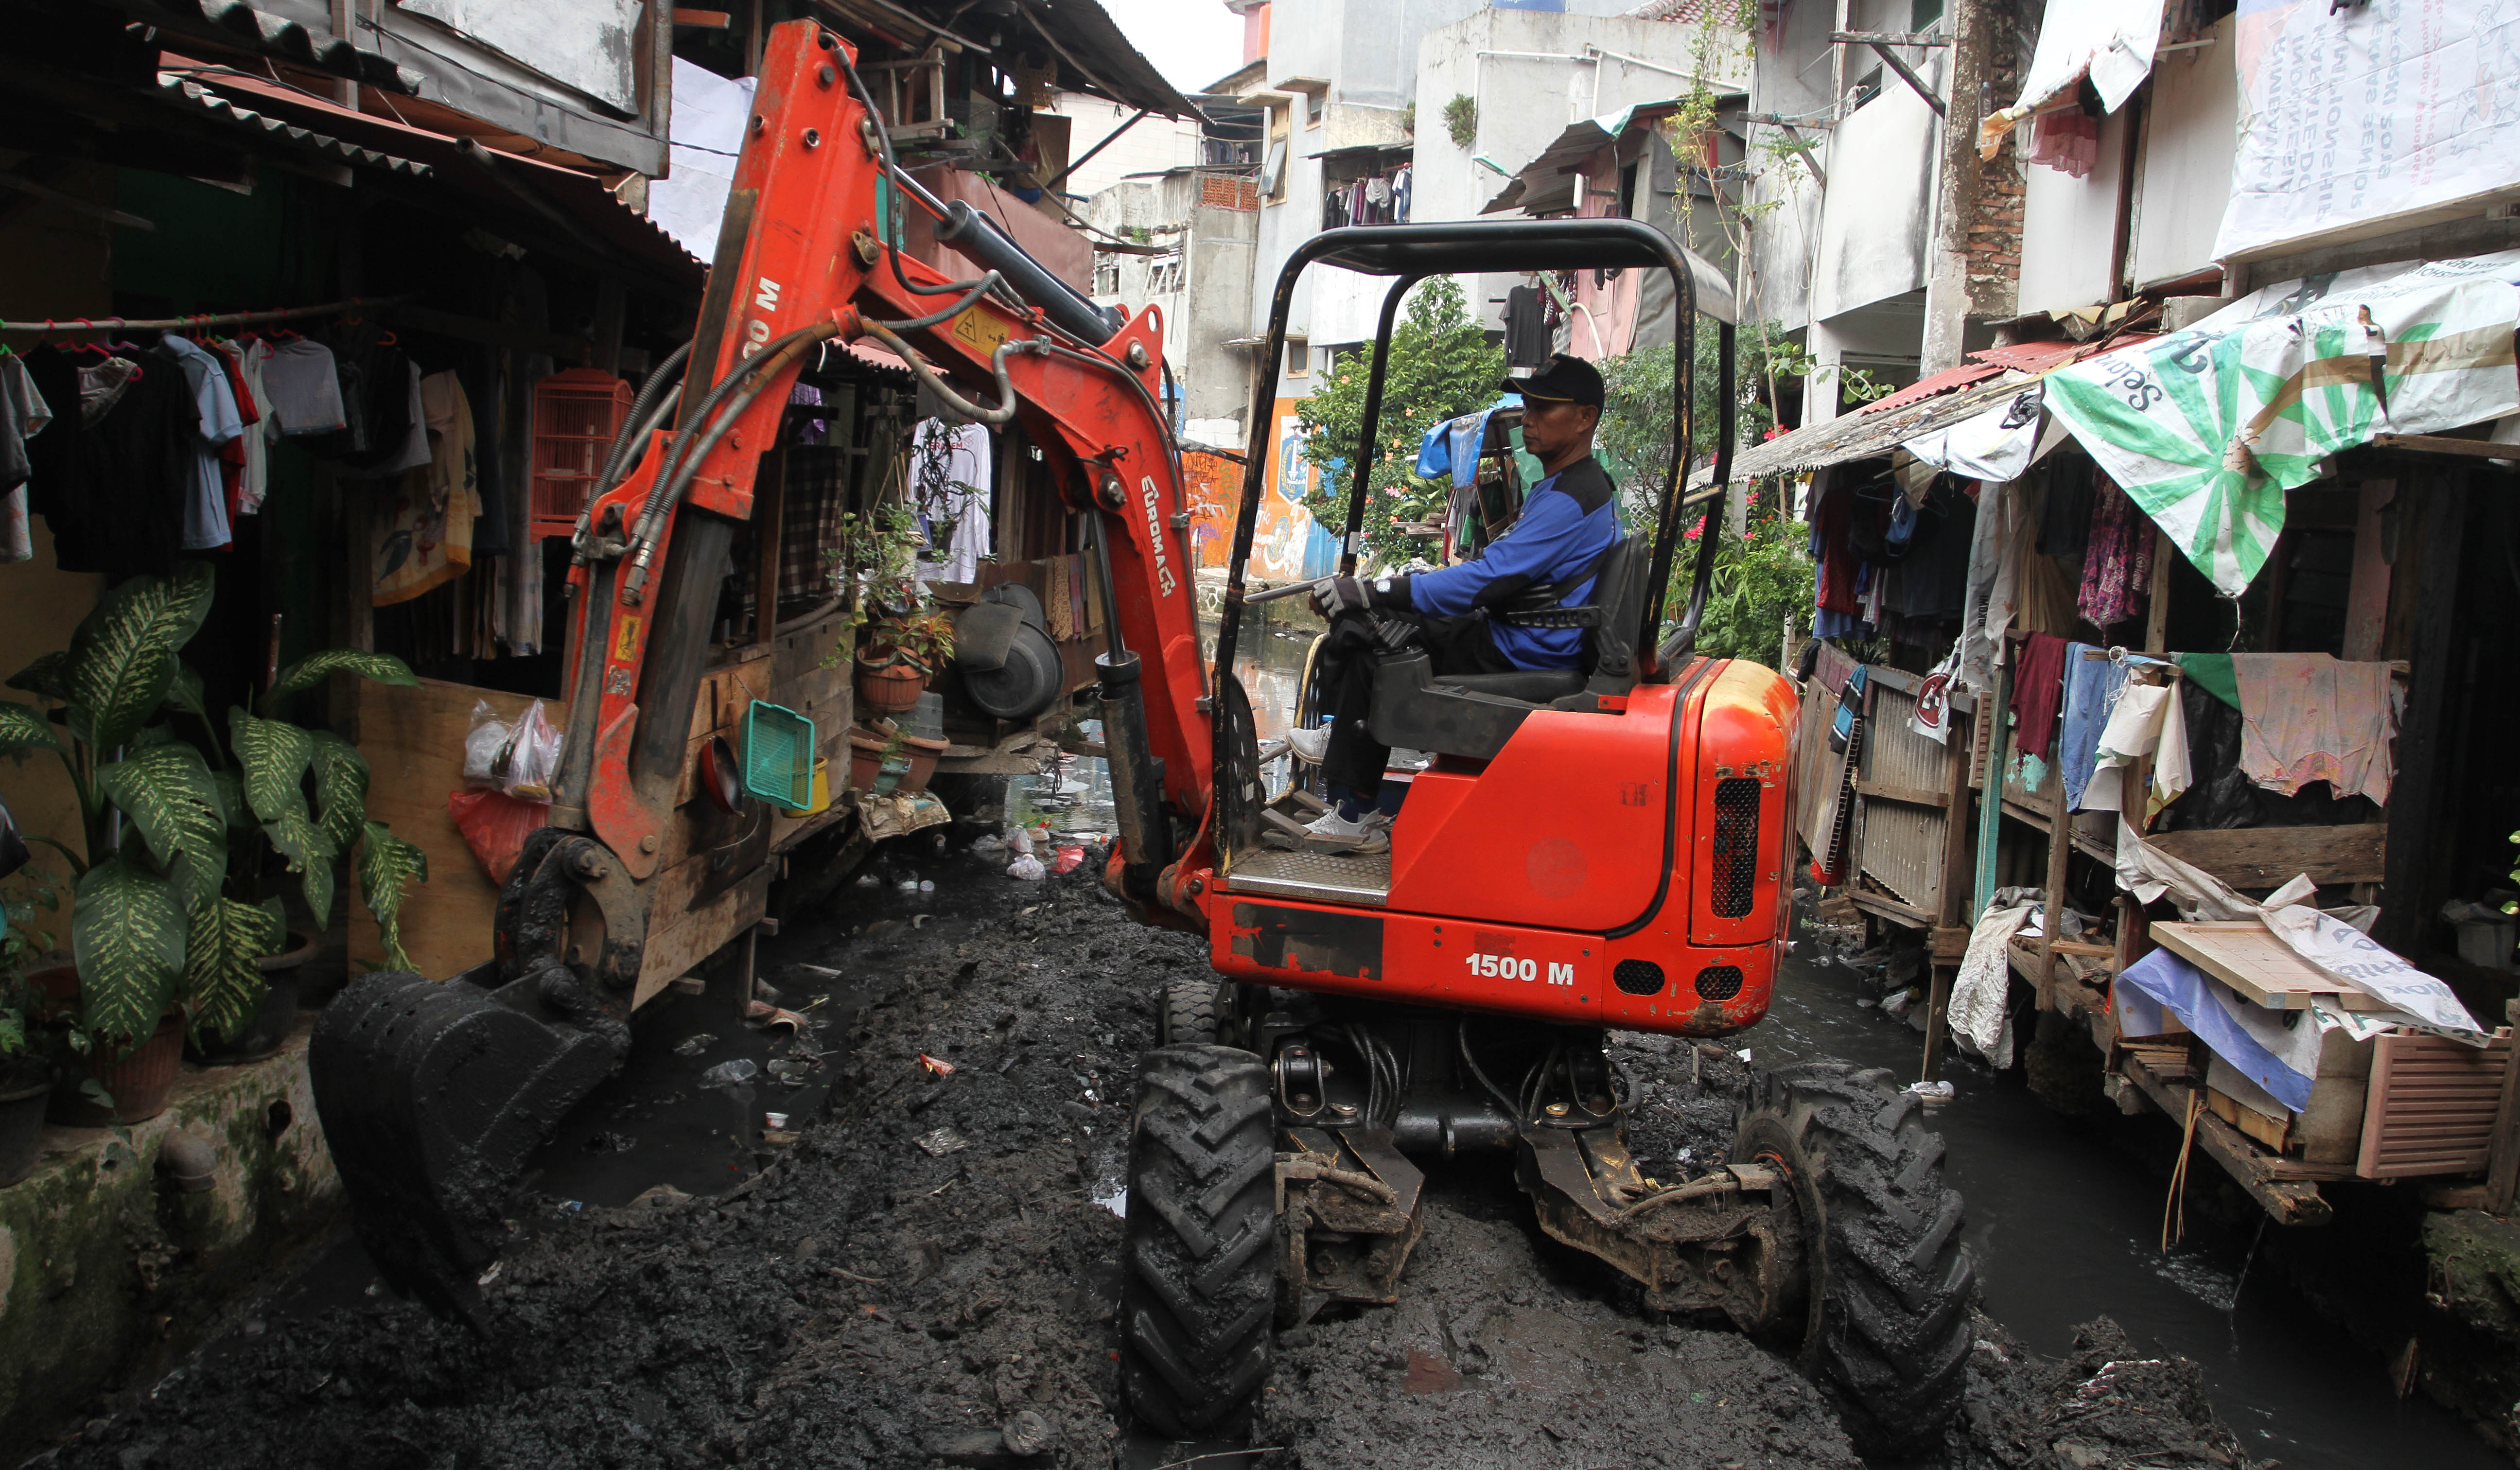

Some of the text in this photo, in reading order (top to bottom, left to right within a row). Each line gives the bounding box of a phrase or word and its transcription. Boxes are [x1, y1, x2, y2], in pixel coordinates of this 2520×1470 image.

[755, 276, 781, 312] M
[1140, 474, 1176, 598] EUROMACH
[1465, 953, 1574, 986] 1500 M
